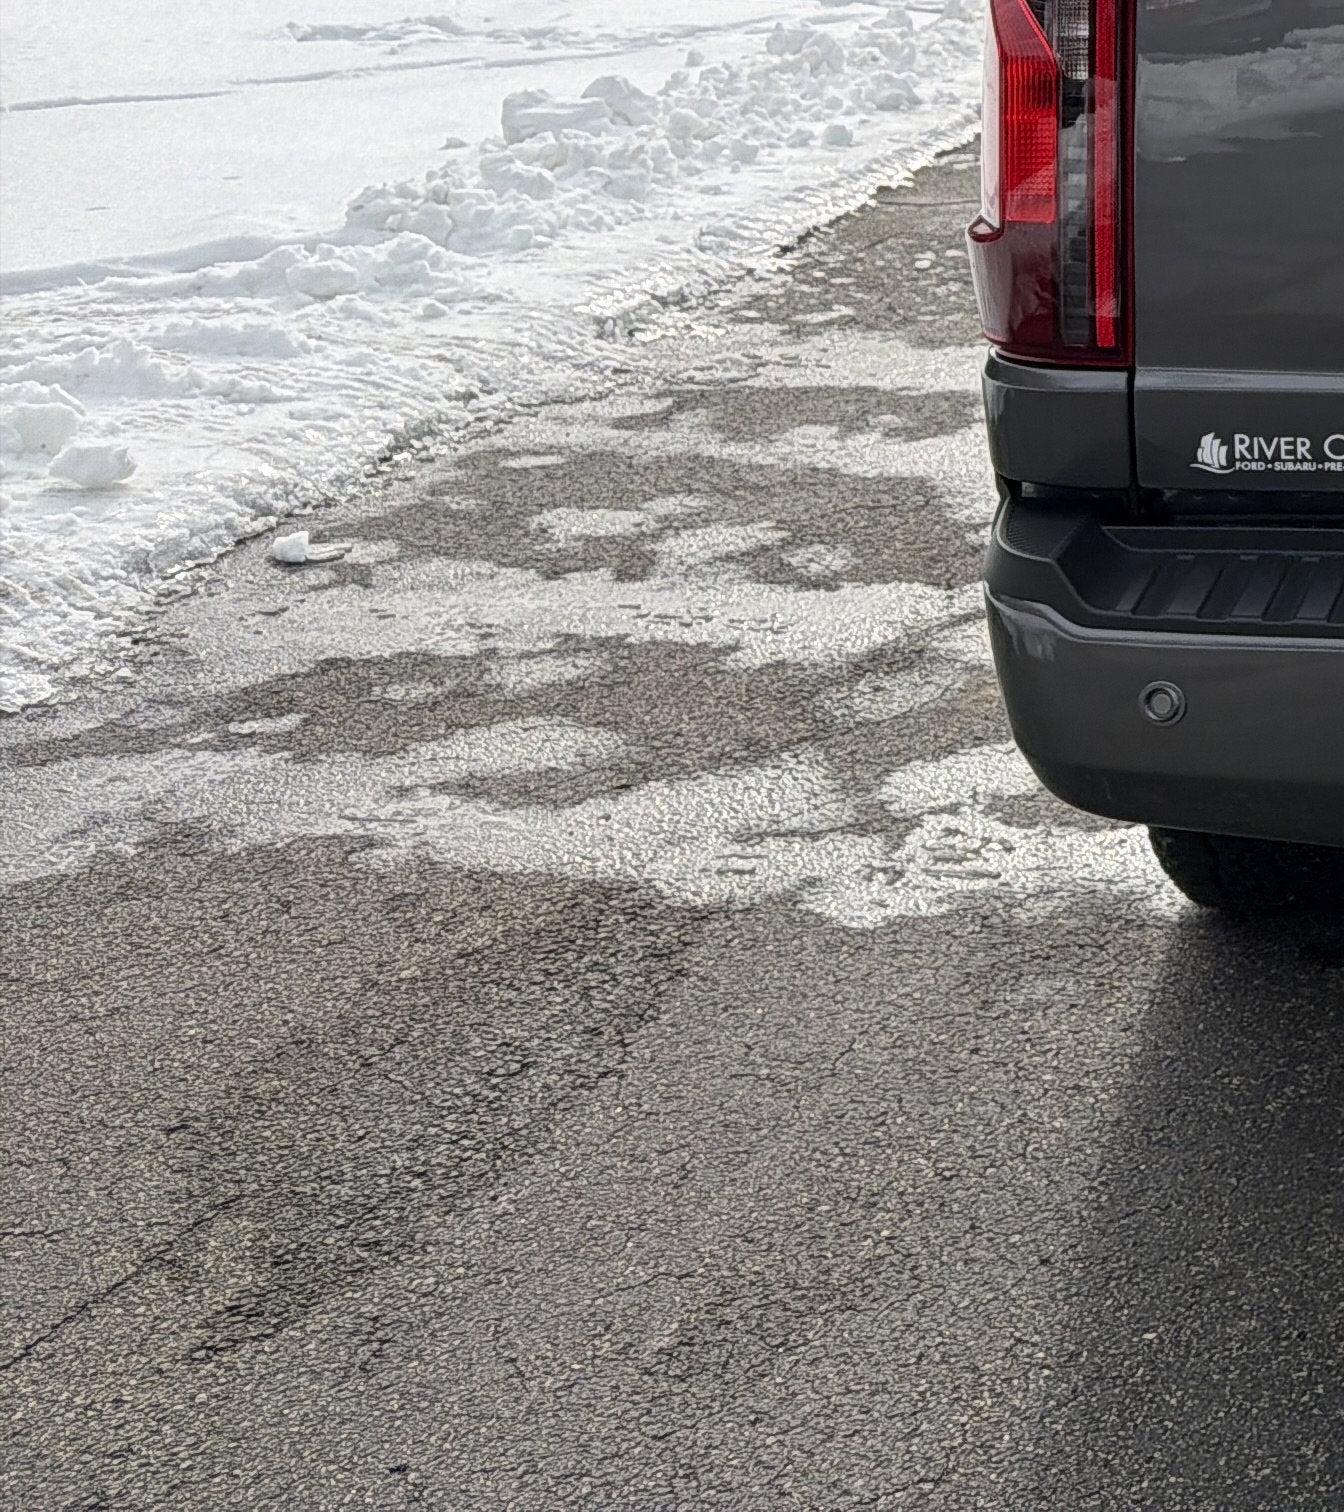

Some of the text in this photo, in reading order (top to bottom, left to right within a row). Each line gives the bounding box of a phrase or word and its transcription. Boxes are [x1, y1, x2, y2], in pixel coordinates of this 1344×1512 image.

[1234, 433, 1312, 460] RIVER
[1235, 461, 1266, 471] FORD
[1273, 461, 1316, 471] SUBARU
